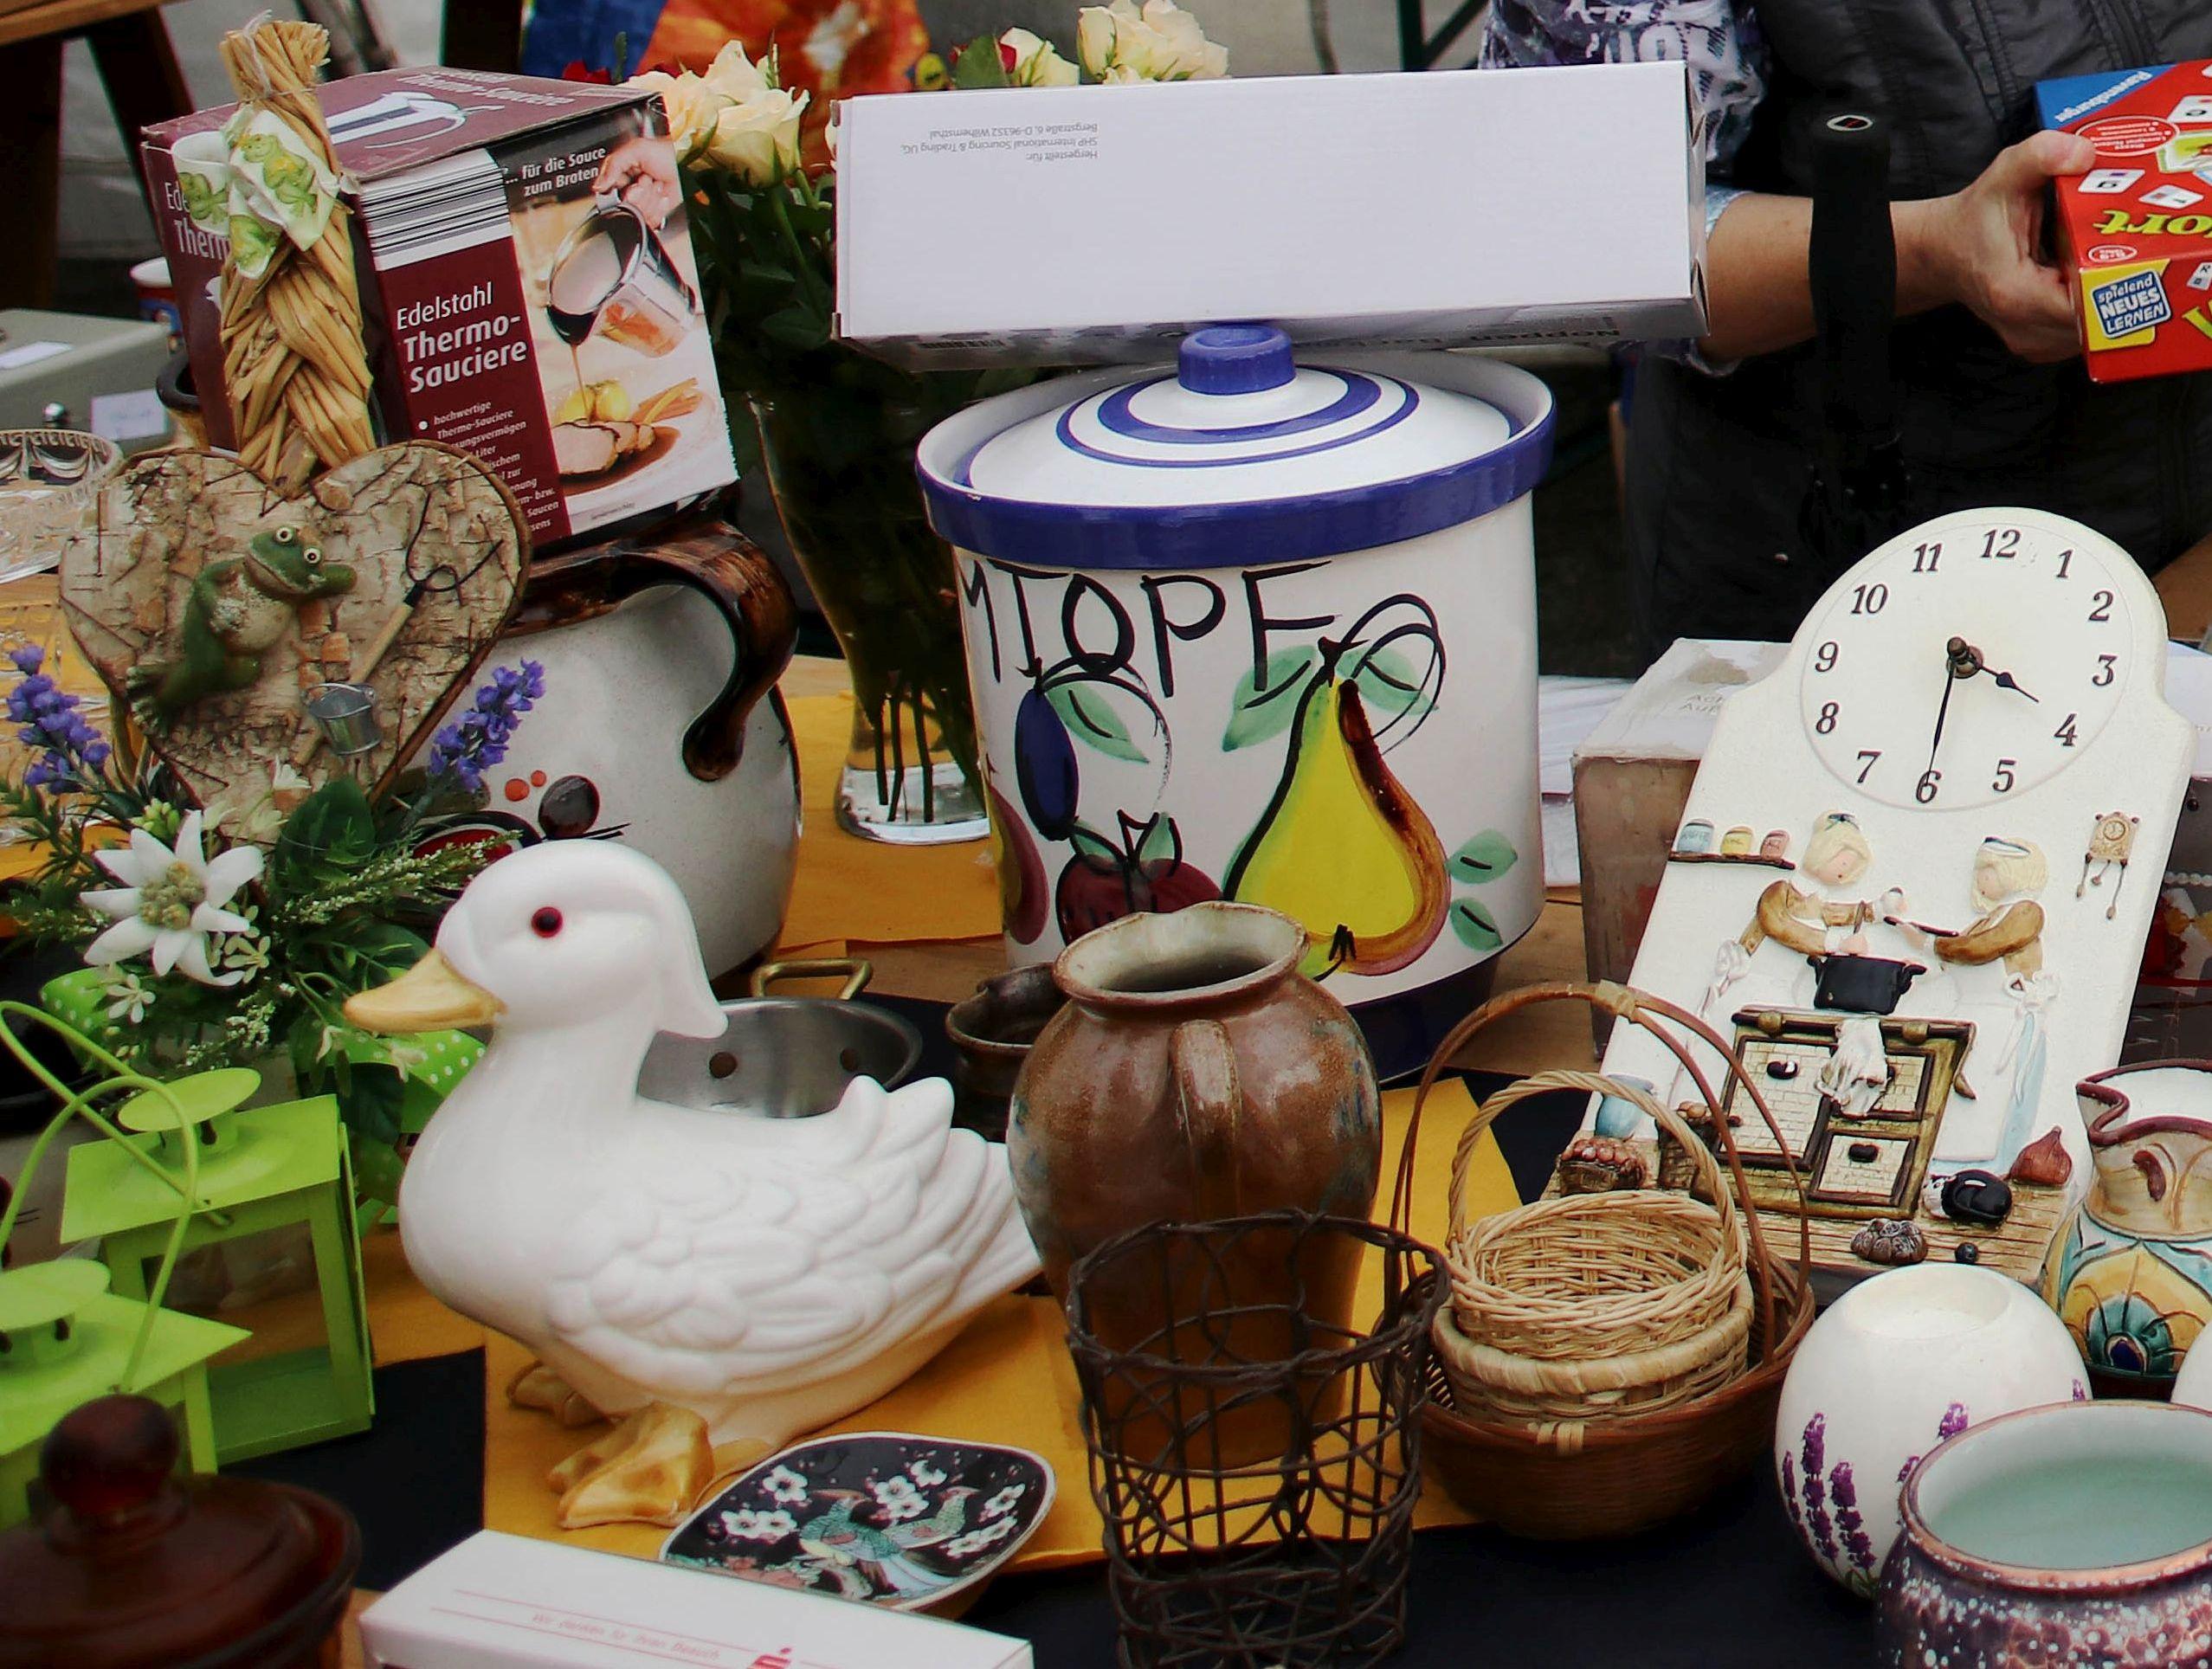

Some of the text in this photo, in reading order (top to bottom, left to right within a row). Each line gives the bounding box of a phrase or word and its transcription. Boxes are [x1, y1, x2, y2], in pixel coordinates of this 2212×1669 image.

[1047, 123, 1098, 133] Bergstraße
[1077, 138, 1098, 147] SHP
[920, 143, 958, 152] Trading
[968, 139, 1012, 150] Sourcing
[1014, 139, 1075, 150] International
[1045, 150, 1098, 161] Hergestellt
[521, 164, 542, 180] für
[545, 157, 566, 173] die
[568, 147, 606, 168] Sauce
[523, 166, 599, 197] zum Braten
[174, 216, 232, 261] Therm
[2093, 209, 2212, 239] ort
[2098, 273, 2153, 305] spielend
[2099, 287, 2161, 319] NEUES
[397, 280, 493, 331] Edelstahl
[2106, 301, 2164, 333] LERNEN
[403, 314, 521, 363] Thermo-
[410, 340, 527, 393] Sauciere
[434, 401, 492, 426] hochwertige
[436, 409, 514, 440] Thermo-Sauciere
[1912, 542, 2074, 578] 11 1
[1980, 529, 2022, 559] 12
[1850, 583, 2114, 622] 10 2
[1815, 641, 2118, 686] 9 3
[1815, 702, 2079, 747] 8 4
[1855, 750, 2016, 793] 7 5
[1915, 770, 1943, 804] 6
